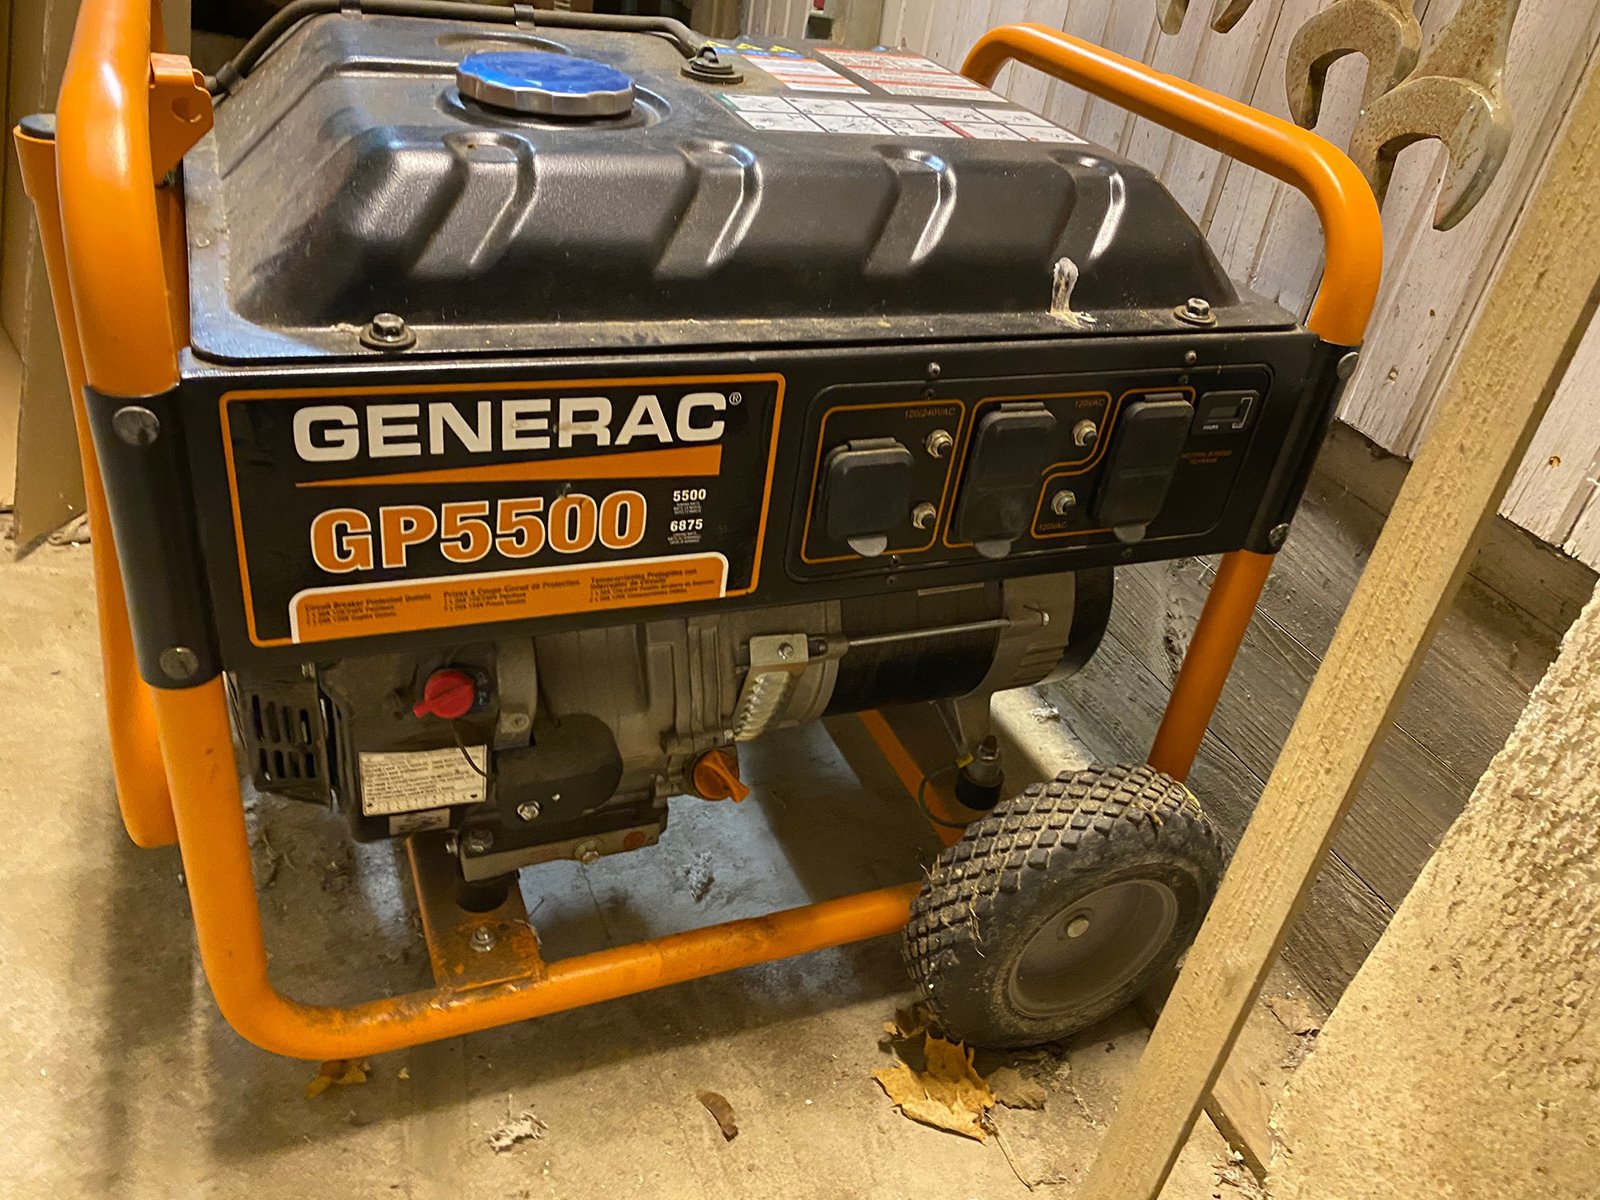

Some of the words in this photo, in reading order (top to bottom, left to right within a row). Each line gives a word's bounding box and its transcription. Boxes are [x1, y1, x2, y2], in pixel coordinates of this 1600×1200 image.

[673, 488, 707, 502] 5500
[310, 490, 648, 574] GP5500
[670, 518, 703, 532] 6875
